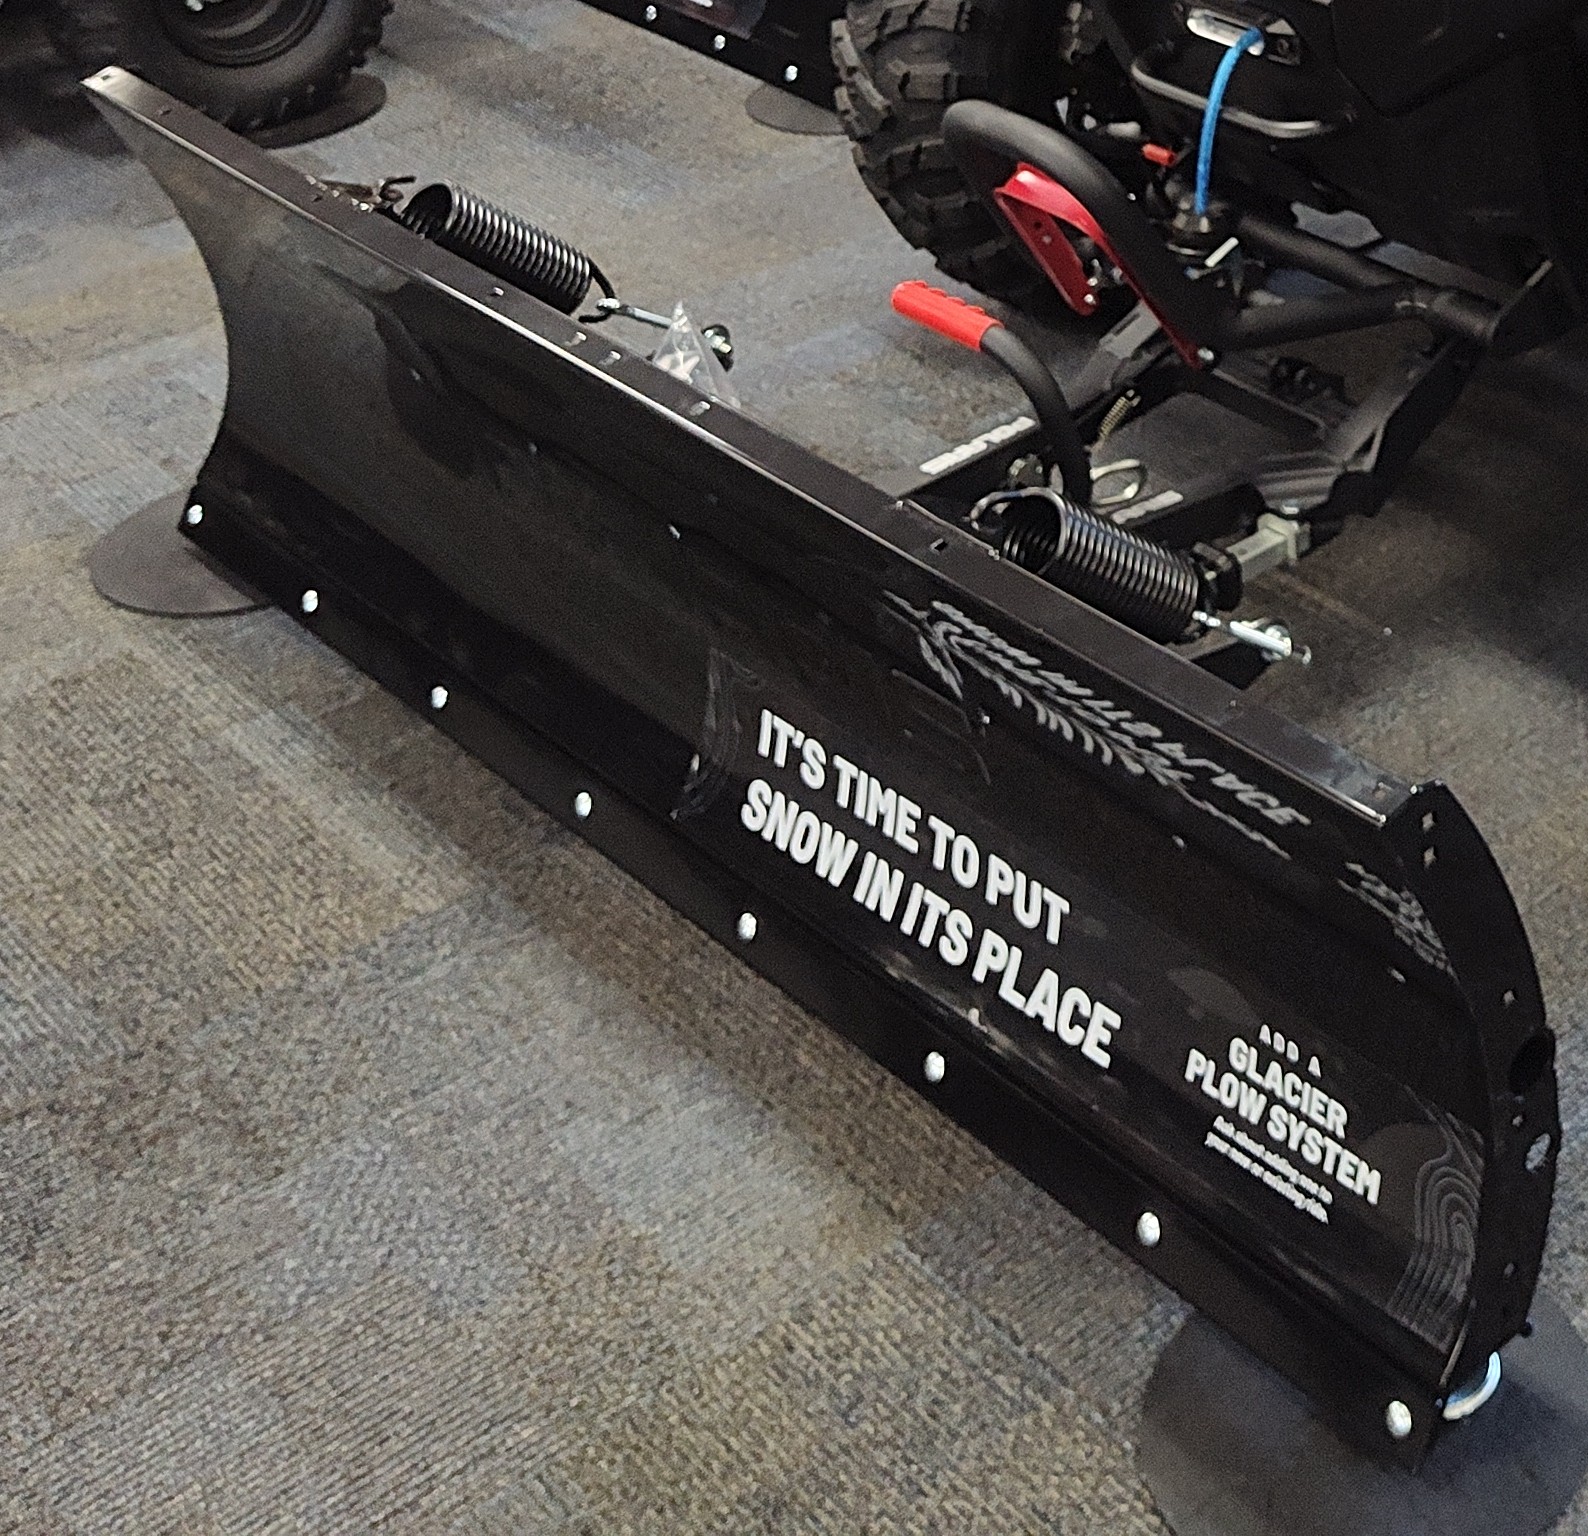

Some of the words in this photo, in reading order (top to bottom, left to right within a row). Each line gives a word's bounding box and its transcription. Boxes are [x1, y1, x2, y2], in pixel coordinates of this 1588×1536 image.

[756, 708, 828, 791] IT'S
[831, 754, 922, 855] TIME
[928, 814, 980, 889] TO
[984, 853, 1071, 945] PUT
[740, 778, 860, 888] SNOW
[852, 850, 905, 923] IN
[899, 881, 974, 966] ITS
[971, 928, 1122, 1069] PLACE
[1184, 1047, 1268, 1126] PLOW
[1266, 1103, 1382, 1206] SYSTEM
[1229, 1036, 1348, 1140] GLACIER
[1258, 1023, 1300, 1064] ADD
[1307, 1056, 1322, 1079] A
